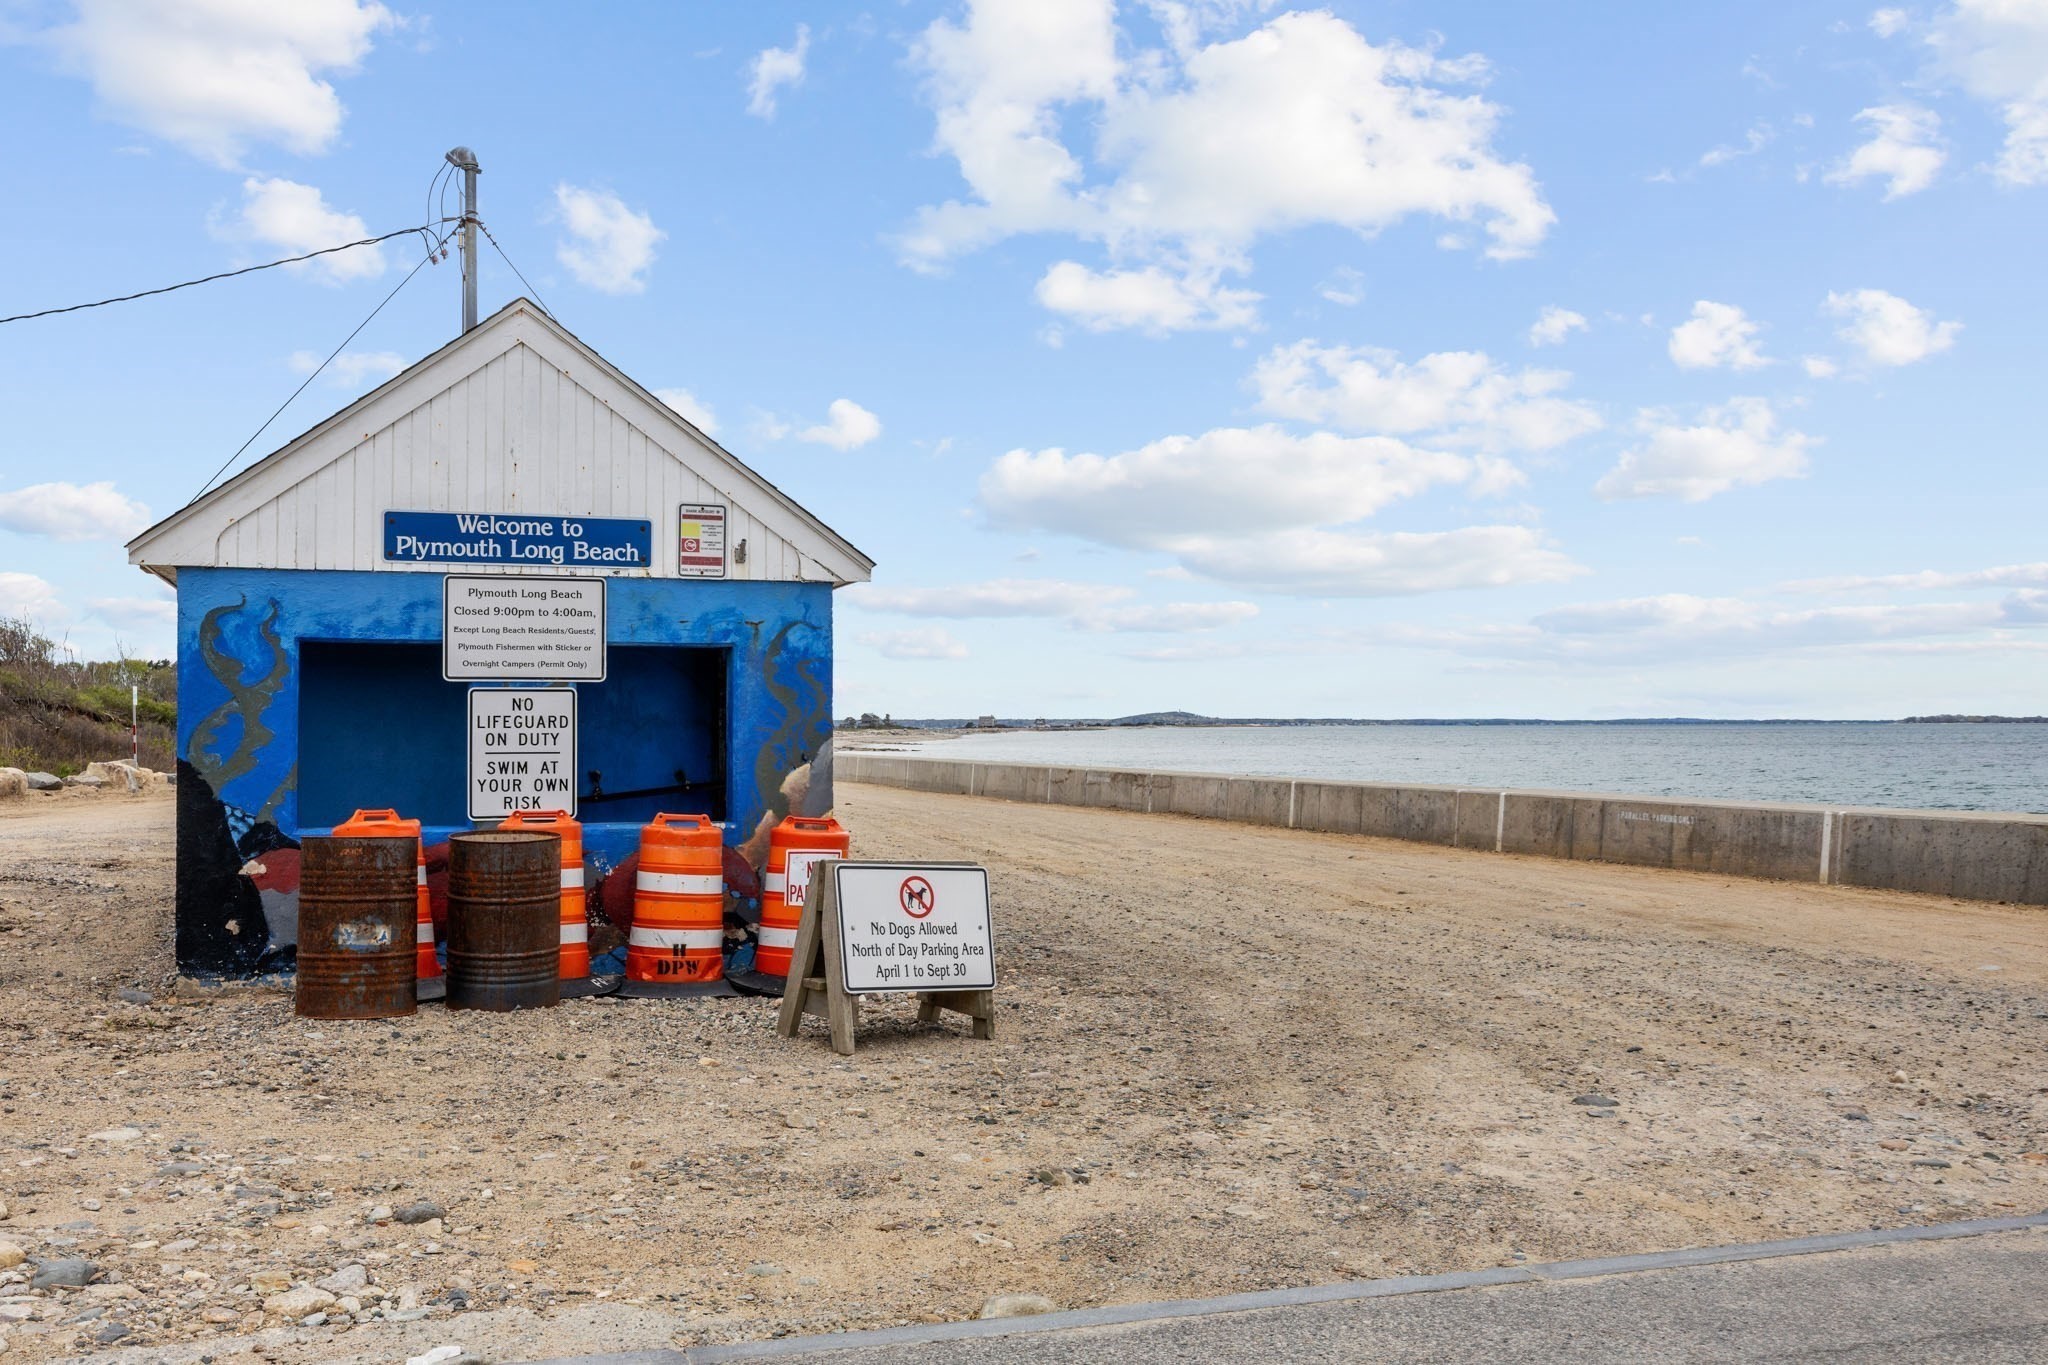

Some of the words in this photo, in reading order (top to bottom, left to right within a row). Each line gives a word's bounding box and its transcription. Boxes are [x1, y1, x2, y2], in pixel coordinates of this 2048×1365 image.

[456, 514, 553, 536] Welcome
[562, 519, 583, 537] to
[396, 535, 501, 560] Plymouth
[510, 539, 564, 565] Long
[573, 541, 639, 562] Beach
[468, 588, 517, 599] Plymouth
[521, 589, 547, 600] Long
[550, 589, 582, 599] Beach
[454, 606, 490, 616] Closed
[493, 606, 535, 618] 9:00pm
[538, 608, 549, 617] to
[552, 607, 596, 619] 4:00am,
[453, 626, 479, 635] Except
[481, 626, 500, 635] Long
[502, 626, 526, 634] Beach
[458, 643, 494, 651] Plymouth
[495, 643, 535, 651] Fishermen
[462, 660, 499, 669] Overnight
[501, 660, 535, 669] Campers
[537, 660, 565, 669] (Permit
[567, 660, 588, 670] Only)
[512, 698, 534, 711] NO
[477, 715, 569, 729] LIFEGUARD
[485, 733, 507, 746] ON
[518, 733, 560, 746] DUTY
[487, 761, 528, 775] SWIM
[540, 761, 558, 775] AT
[477, 779, 522, 792] YOUR
[534, 778, 569, 792] OWN
[503, 796, 541, 810] RISK
[870, 922, 885, 935] No
[889, 922, 915, 938] Dogs
[918, 922, 957, 935] Allowed
[852, 943, 881, 957] North
[885, 943, 895, 956] of
[898, 943, 918, 959] Day
[921, 942, 958, 959] Parking
[962, 942, 984, 956] Area
[657, 959, 700, 975] DPW
[876, 964, 900, 981] April
[904, 964, 909, 977] 1
[913, 965, 923, 977] to
[927, 963, 950, 980] Sept
[953, 963, 966, 977] 30
